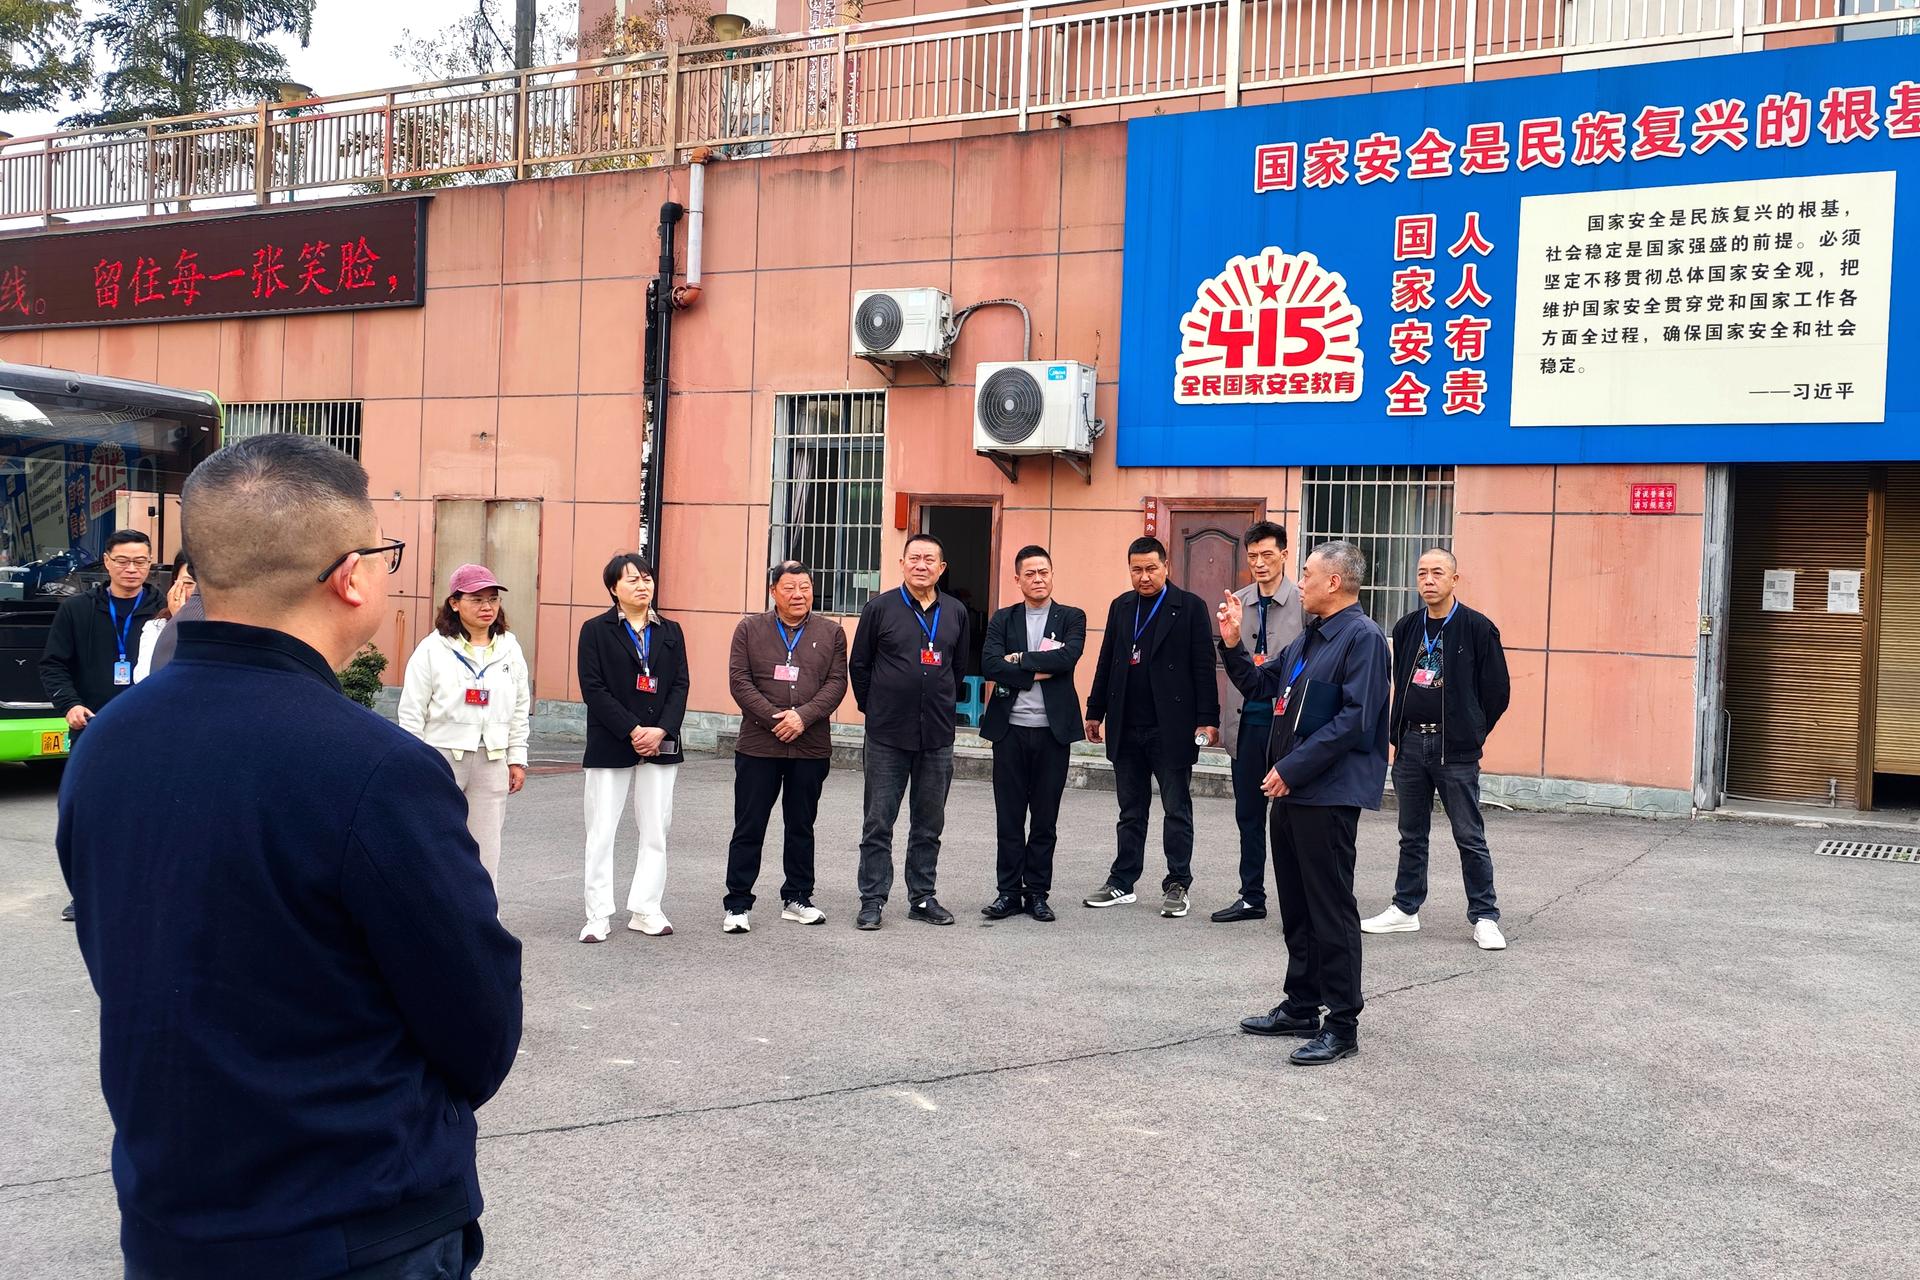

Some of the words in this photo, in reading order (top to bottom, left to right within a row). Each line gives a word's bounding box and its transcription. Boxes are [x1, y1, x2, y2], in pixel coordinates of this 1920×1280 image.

[1255, 83, 1920, 190] 国家安全是民族复兴的根基
[1588, 199, 1852, 232] 国家安全是民族复兴的根基，
[92, 235, 399, 309] 留住每一张笑脸，
[1389, 216, 1434, 413] 国家安全
[1446, 214, 1491, 412] 人人有责
[1542, 288, 1858, 319] 维护国家安全贯穿党和国家工作各
[1207, 306, 1326, 369] 415
[1541, 318, 1857, 347] 方面全过程，确保国家安全和社会
[1181, 371, 1356, 397] 全民国家安全教育
[1540, 356, 1585, 375] 稳定。
